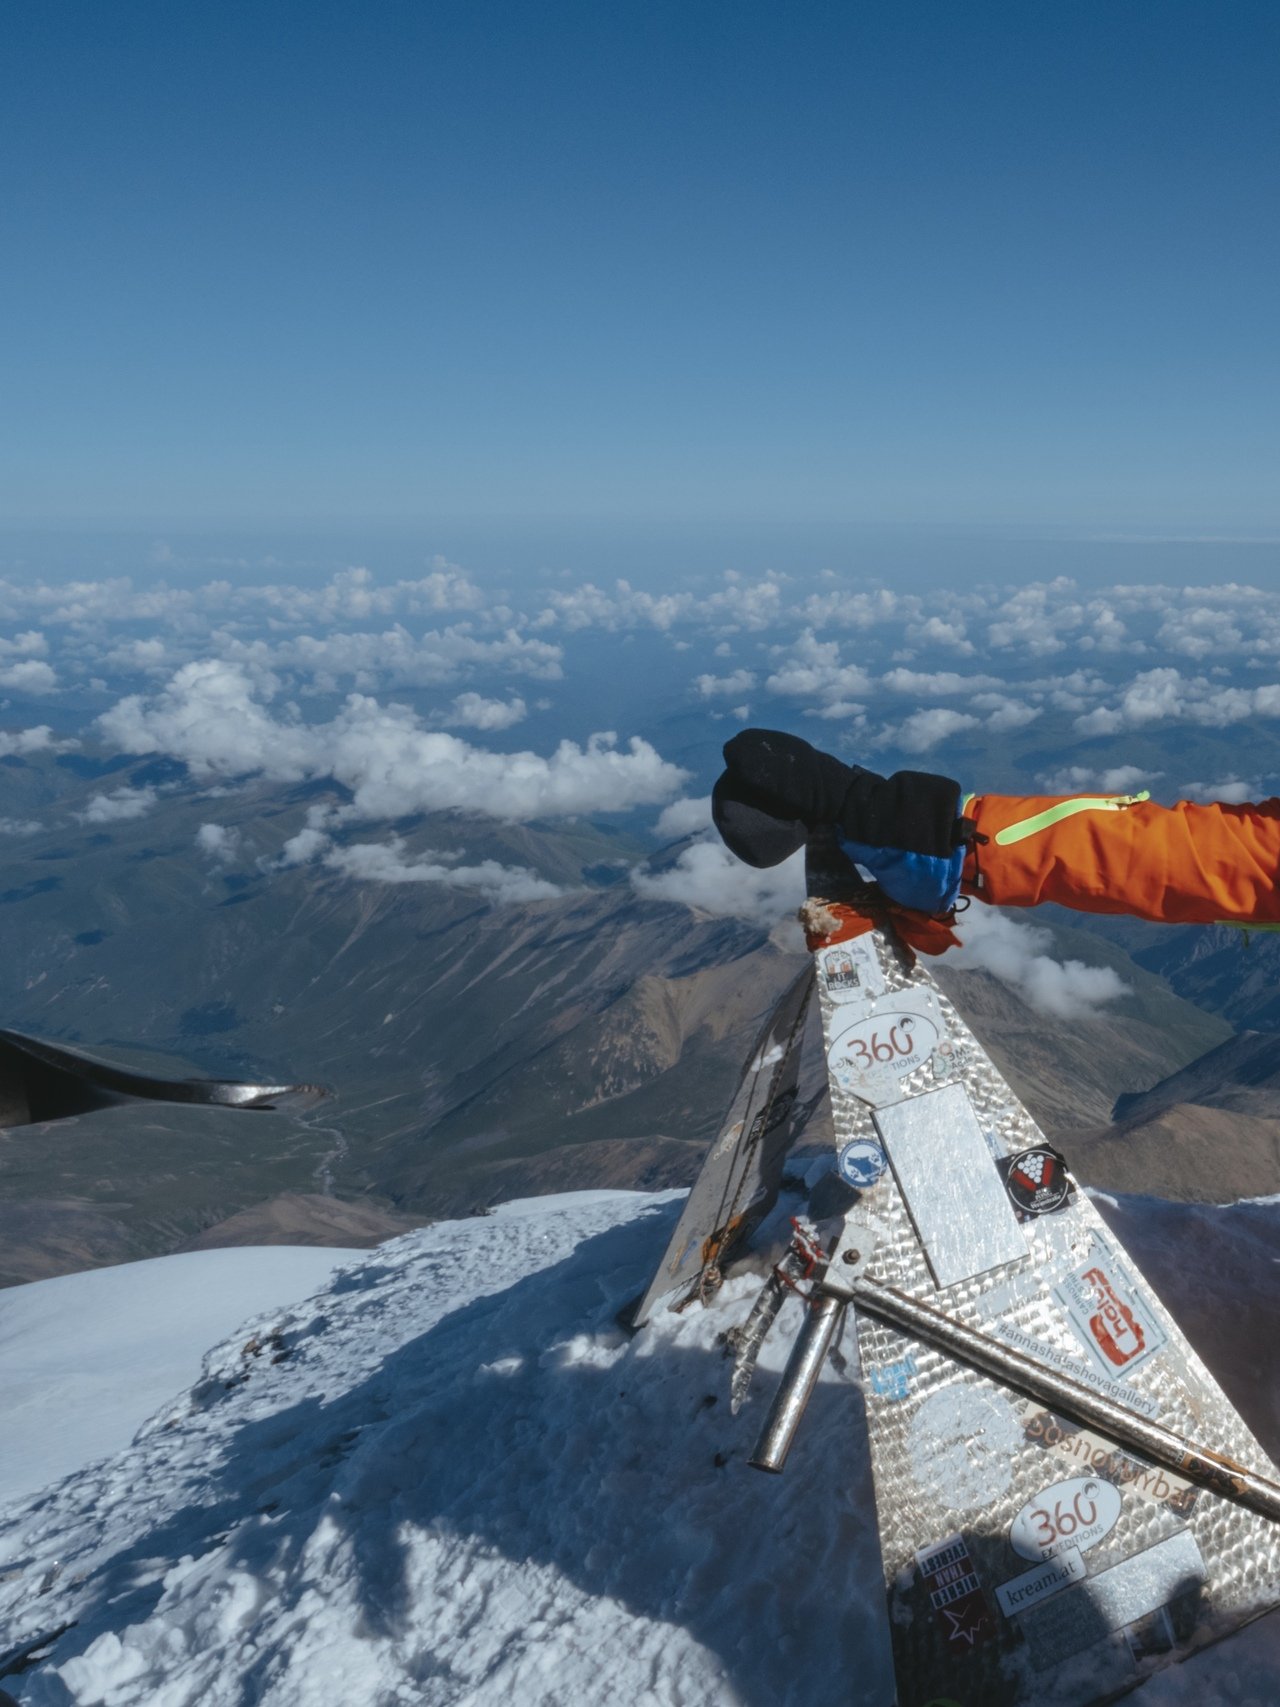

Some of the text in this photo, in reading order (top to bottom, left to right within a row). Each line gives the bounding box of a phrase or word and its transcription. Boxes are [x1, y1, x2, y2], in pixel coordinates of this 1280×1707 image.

[828, 978, 860, 992] ROCKS
[837, 972, 847, 982] IT
[847, 1026, 913, 1070] 360
[1030, 1492, 1097, 1547] 360
[1042, 1524, 1104, 1559] EXEDITIONS
[921, 1542, 967, 1577] EVEREST
[935, 1563, 965, 1588] THAN
[932, 1574, 979, 1608] HIGHER
[1006, 1562, 1077, 1606] kream.at
